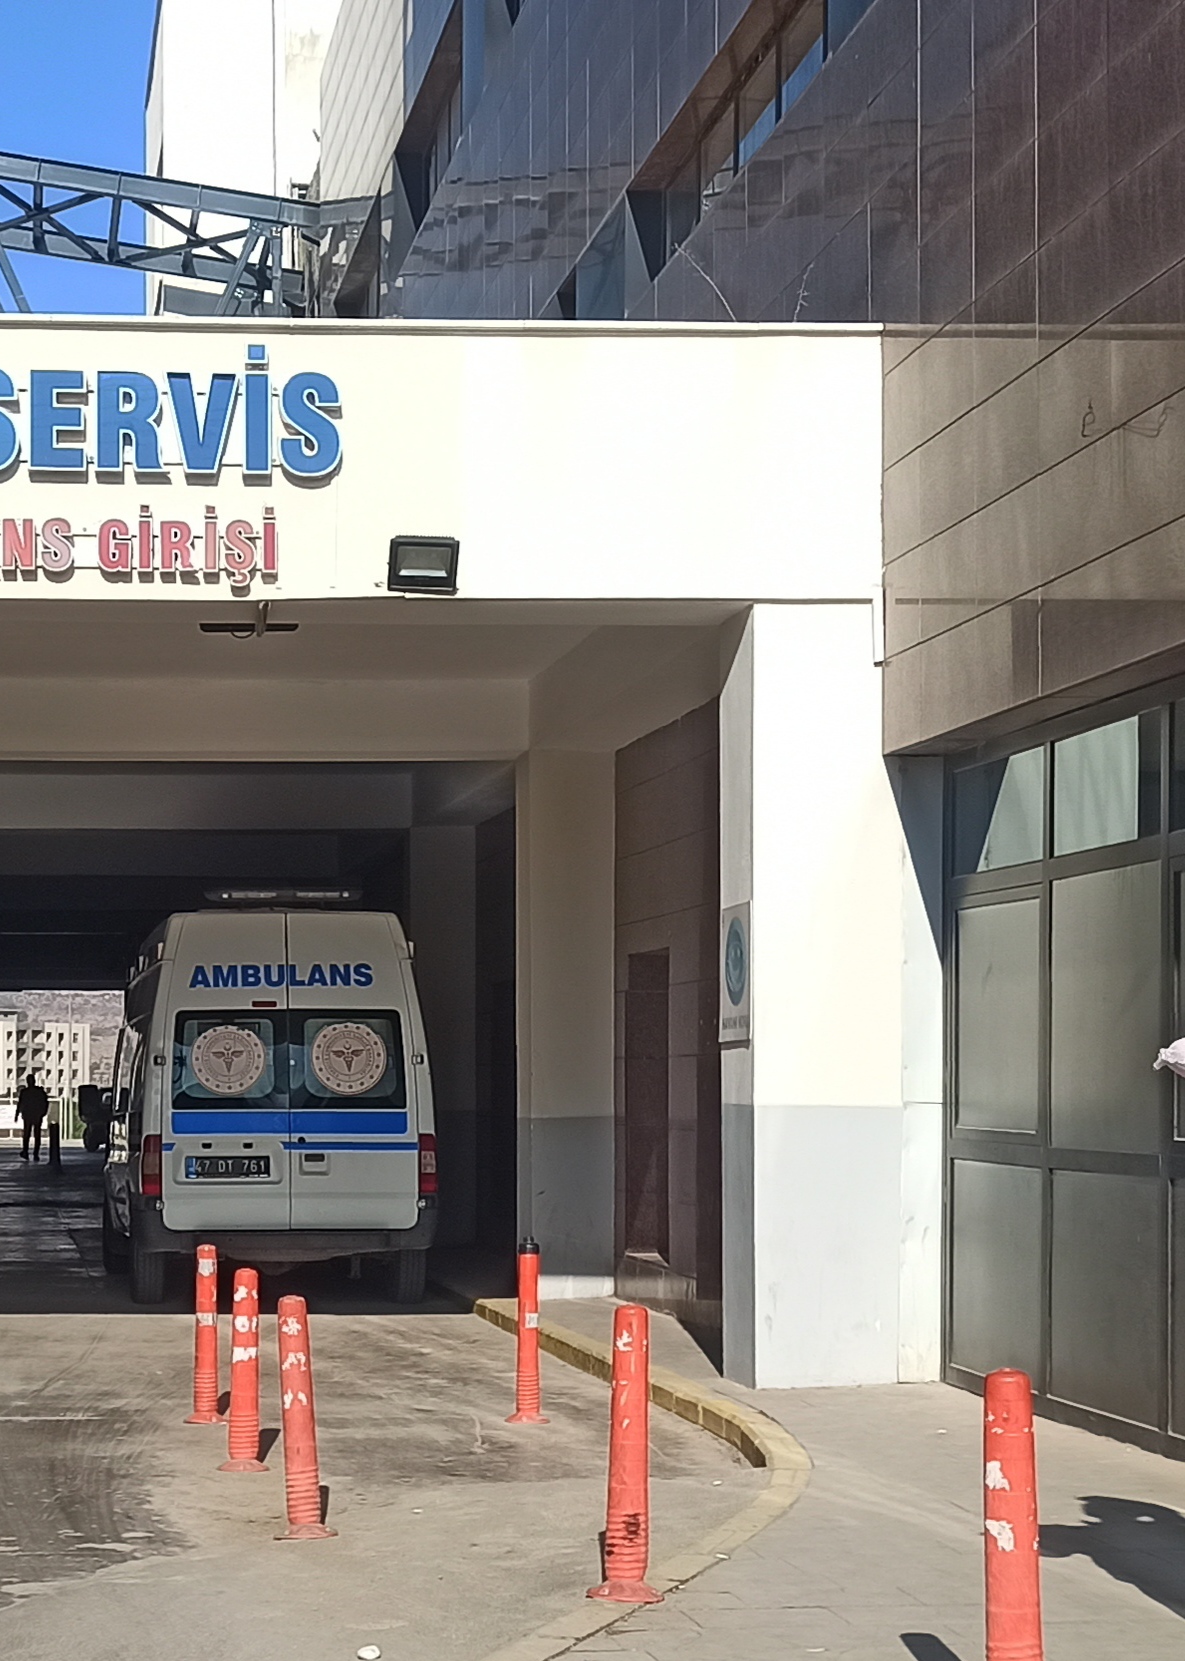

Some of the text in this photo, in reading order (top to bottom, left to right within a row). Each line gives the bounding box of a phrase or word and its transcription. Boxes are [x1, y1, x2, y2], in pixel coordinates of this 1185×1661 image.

[96, 505, 279, 586] GİRİŞİ
[189, 963, 375, 988] AMBULANS
[218, 1160, 233, 1173] DT
[242, 1160, 265, 1173] 761
